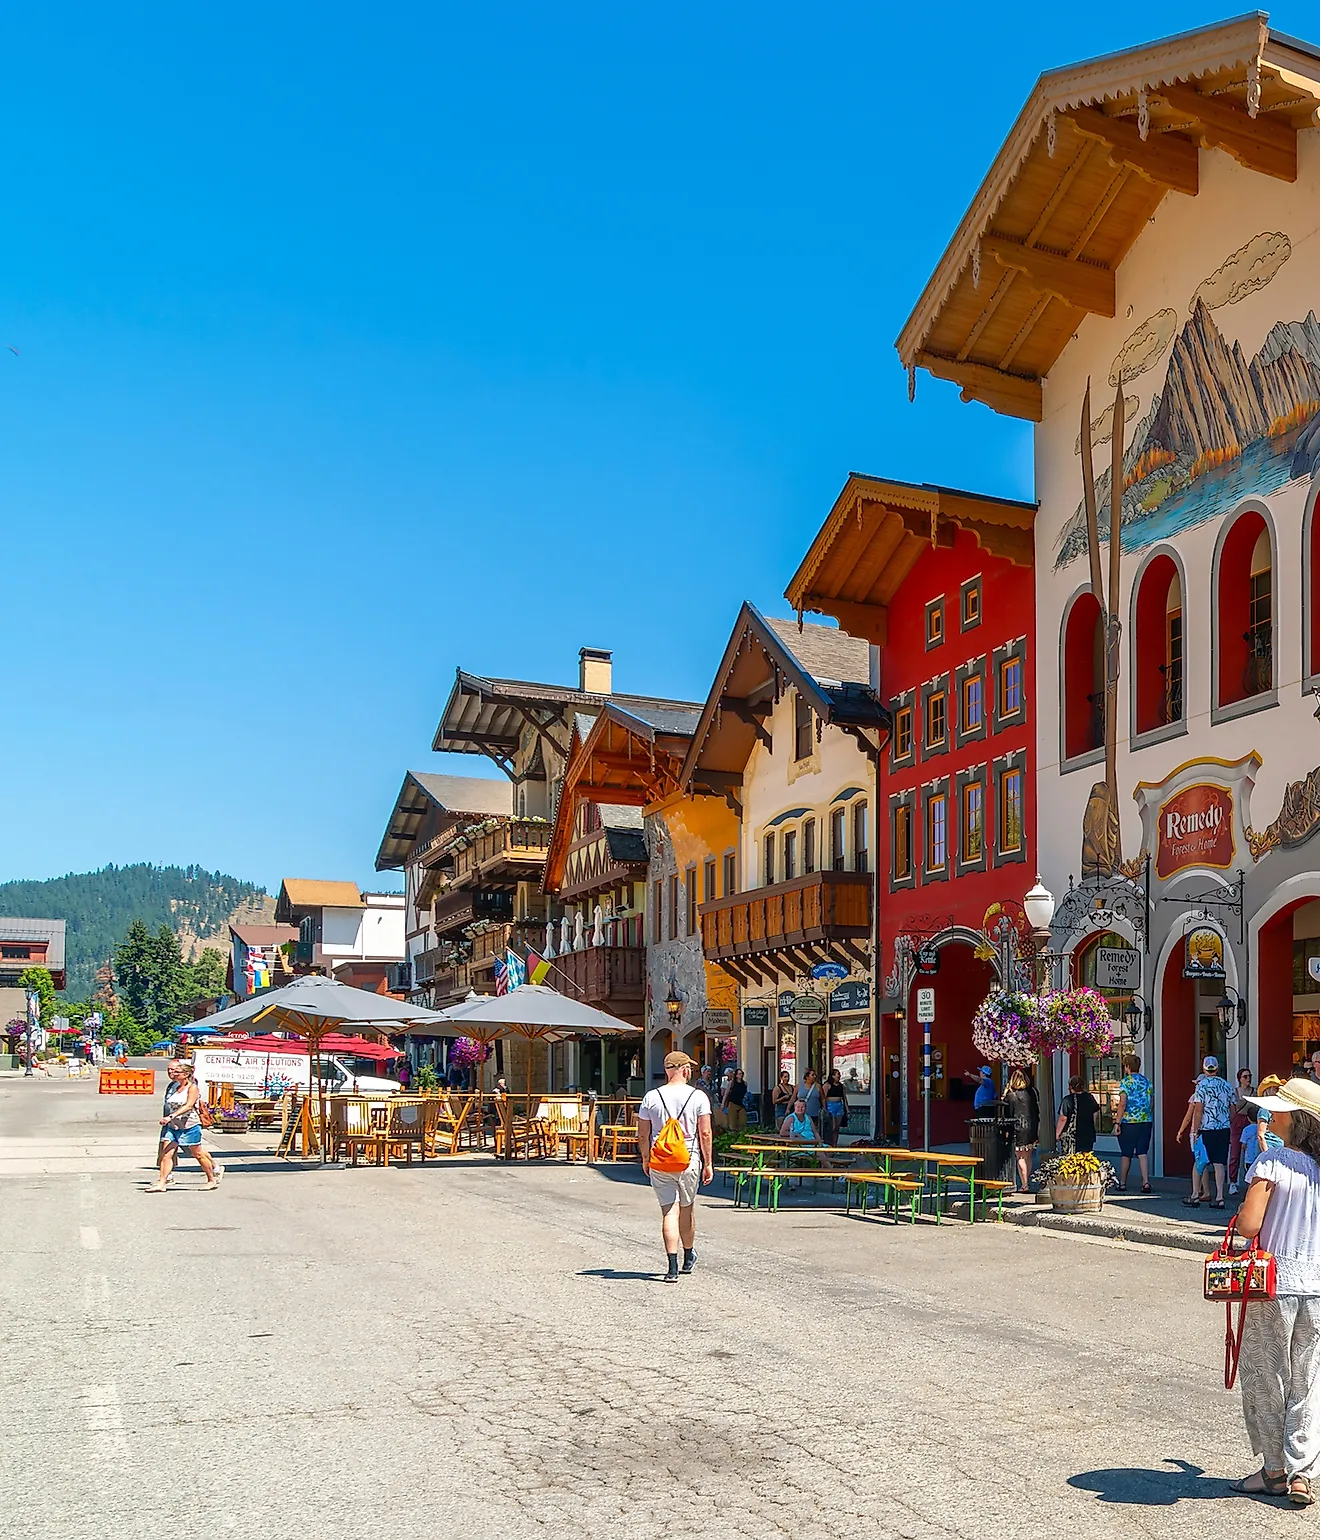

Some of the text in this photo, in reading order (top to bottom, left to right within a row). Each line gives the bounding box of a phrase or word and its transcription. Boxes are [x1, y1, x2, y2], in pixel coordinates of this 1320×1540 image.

[1167, 804, 1222, 839] Remedy
[1172, 843, 1190, 856] Forest
[1198, 838, 1217, 850] Home
[1100, 950, 1136, 966] Remedy
[1107, 963, 1128, 972] Forest
[1109, 977, 1127, 985] Home
[921, 991, 931, 1000] 30
[205, 1056, 239, 1064] CENTRA
